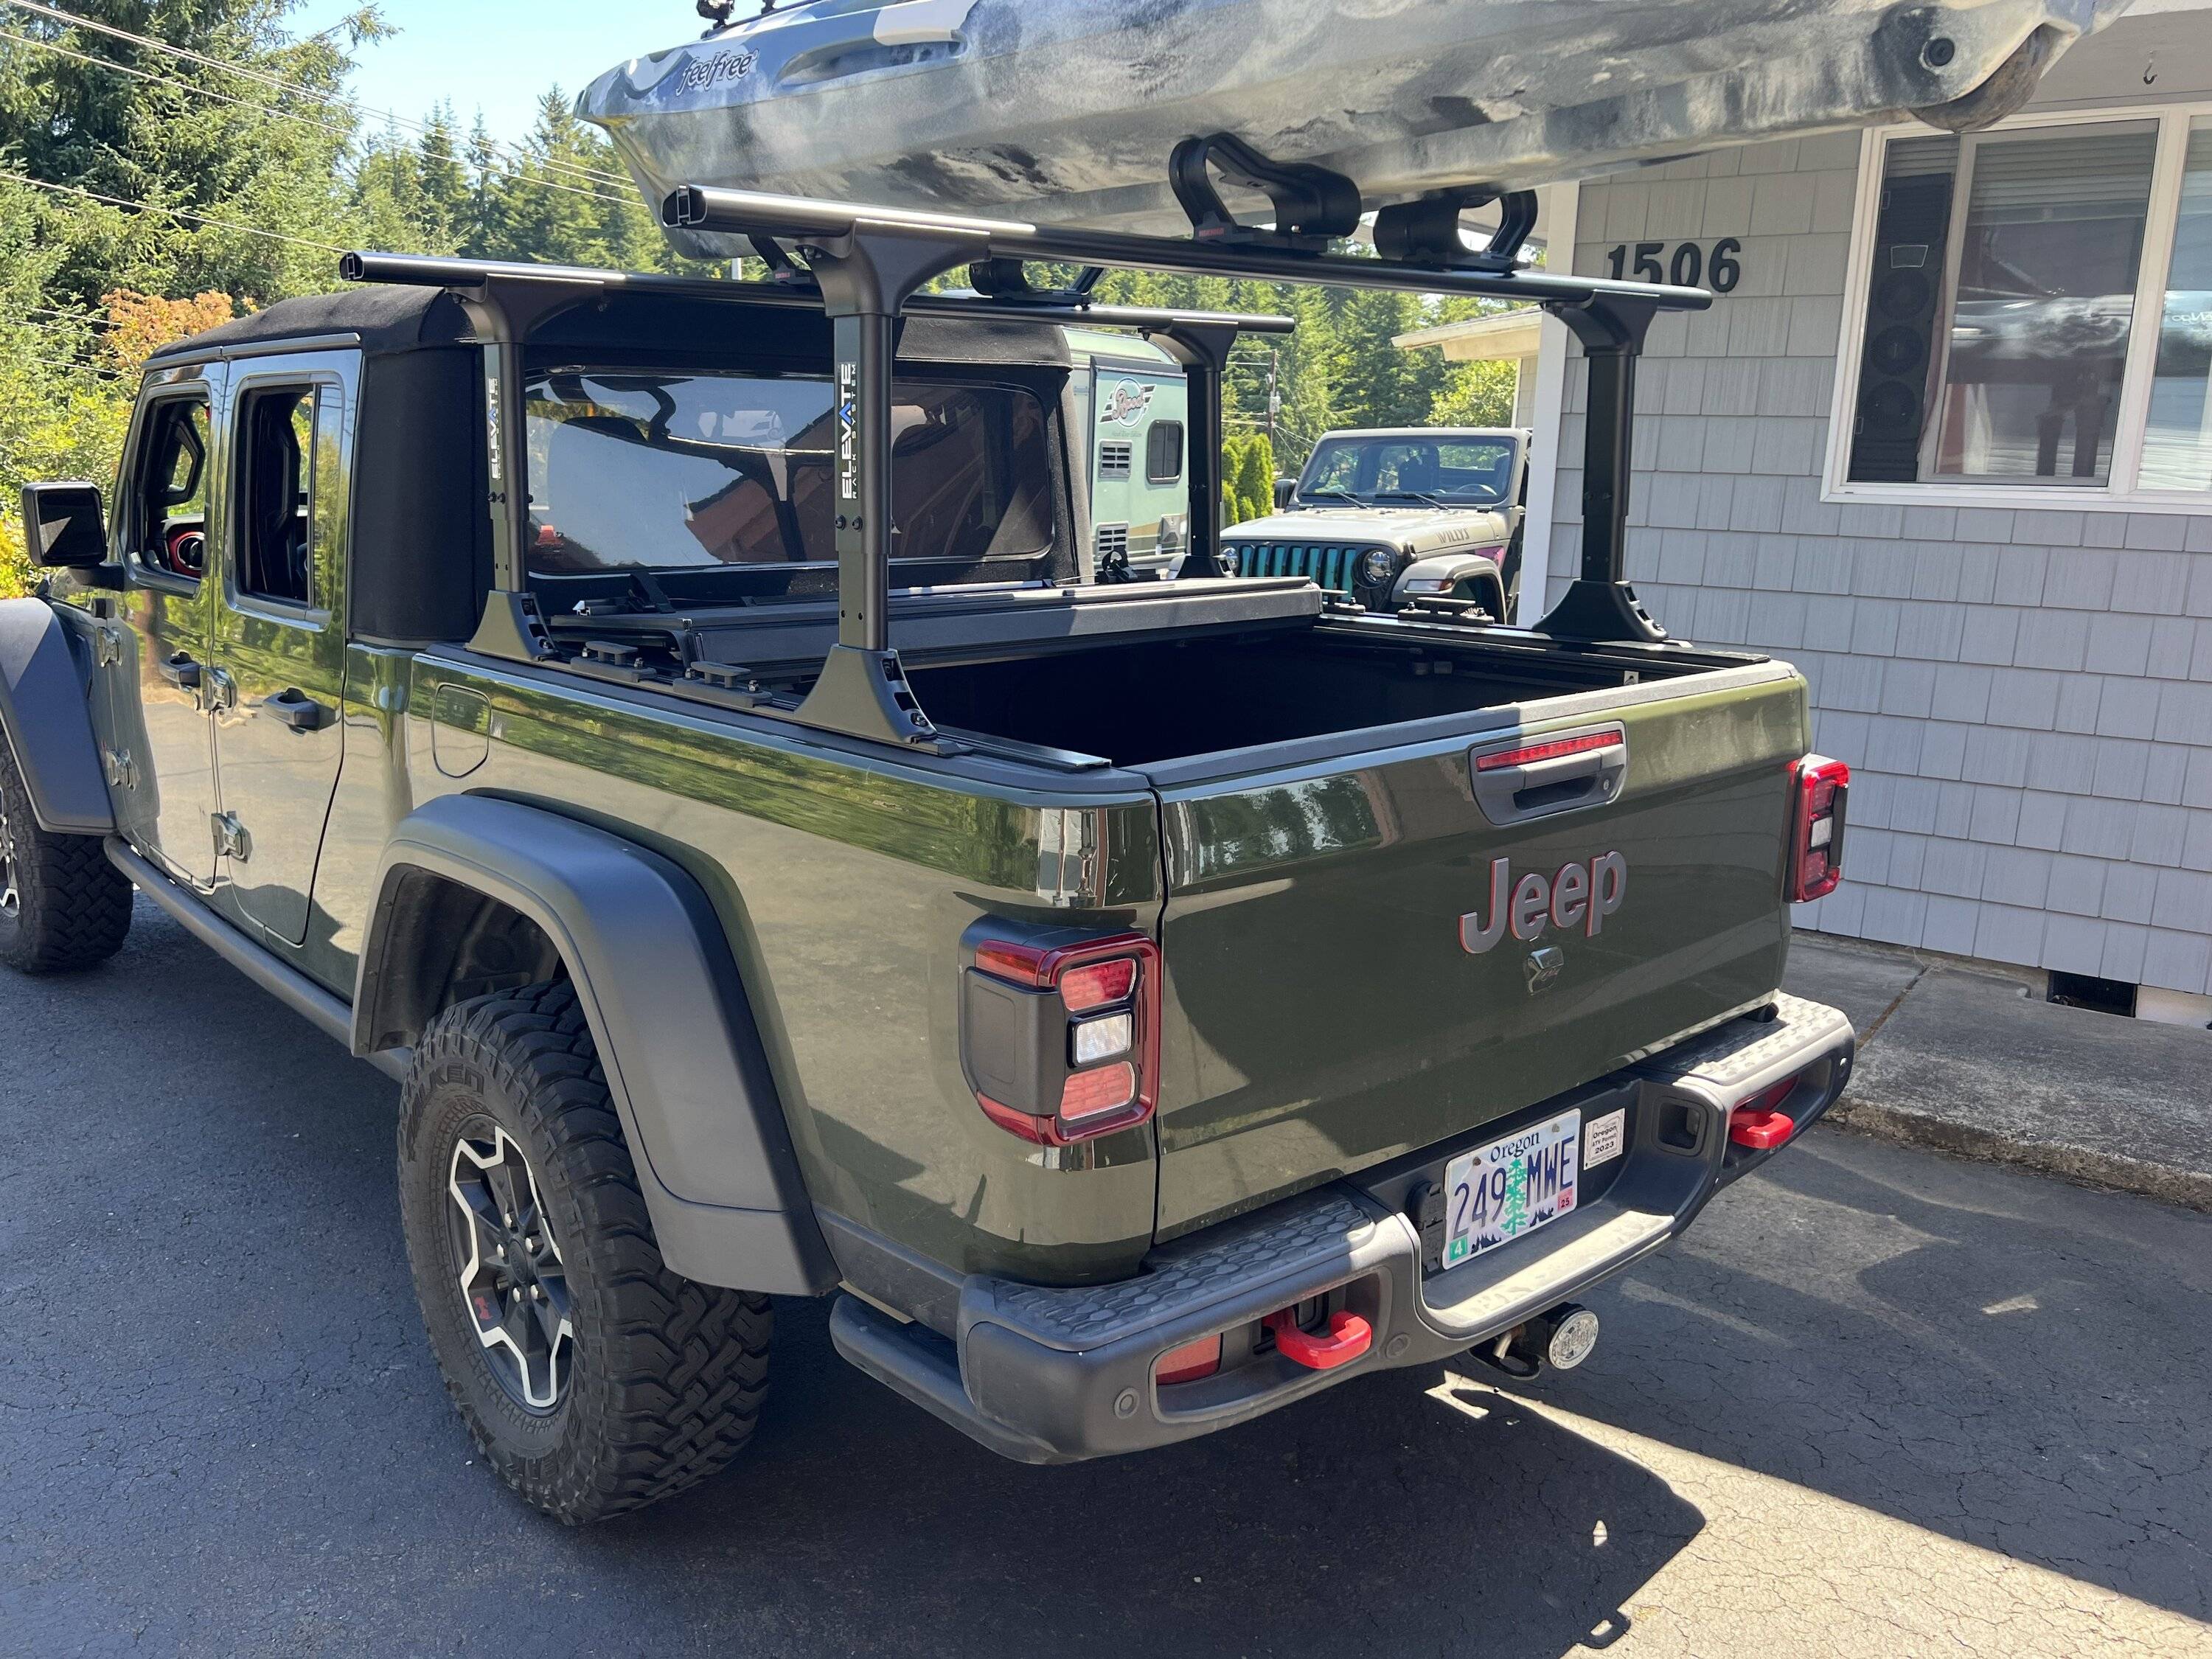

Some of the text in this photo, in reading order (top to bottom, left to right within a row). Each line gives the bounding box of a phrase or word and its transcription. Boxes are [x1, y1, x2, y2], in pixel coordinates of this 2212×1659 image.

[676, 49, 757, 97] feelfree
[1608, 237, 1741, 293] 1506
[488, 378, 498, 479] ELEVATE
[839, 364, 852, 499] ELEVATE
[1436, 527, 1470, 543] WILLYS
[1458, 851, 1627, 953] Jeep
[1489, 1132, 1540, 1162] Oregon
[1593, 1126, 1617, 1138] Oregon
[1595, 1141, 1614, 1154] 2023
[1453, 1135, 1575, 1239] 249 MWE
[1561, 1197, 1570, 1208] 25
[1454, 1240, 1463, 1255] 4
